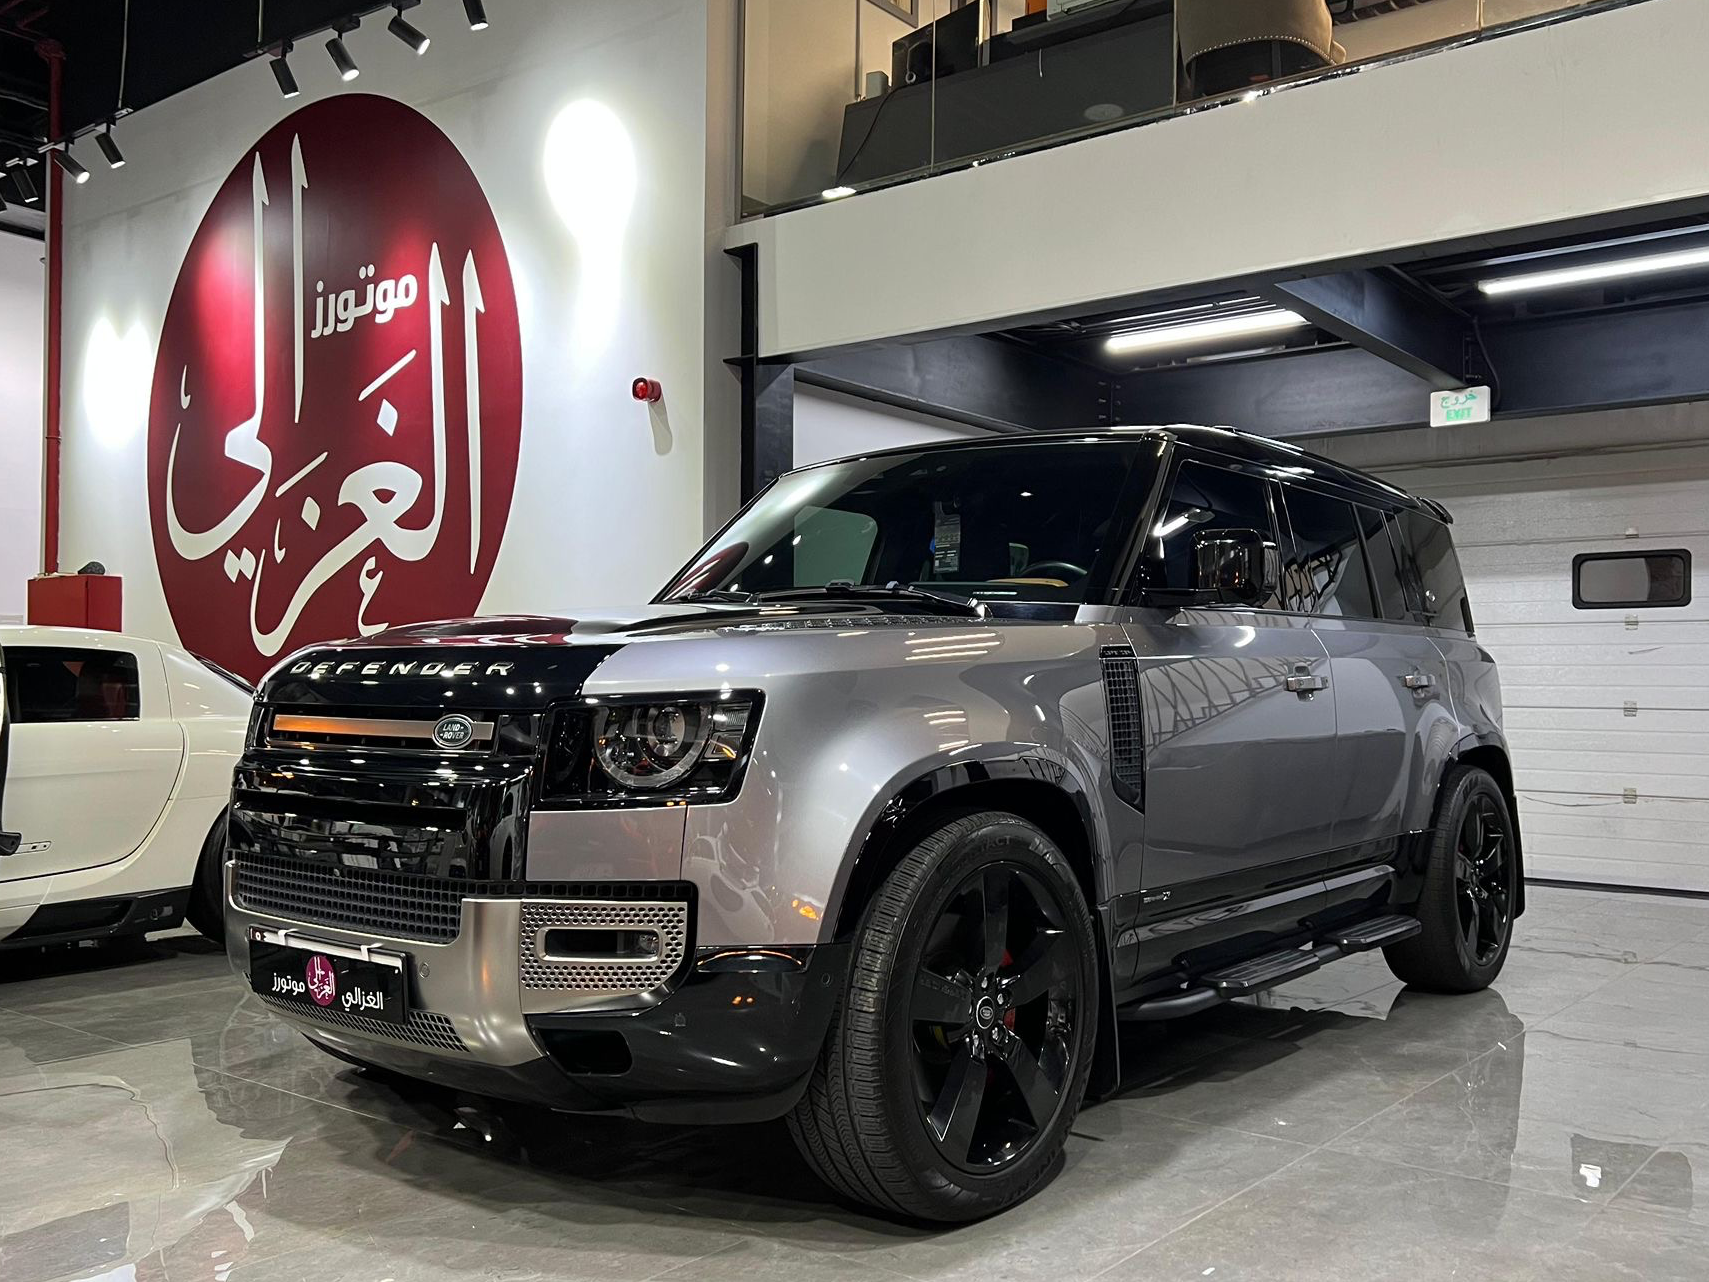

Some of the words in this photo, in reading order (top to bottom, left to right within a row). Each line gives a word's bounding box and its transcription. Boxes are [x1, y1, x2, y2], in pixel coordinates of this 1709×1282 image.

[310, 264, 419, 339] موتورز
[1441, 390, 1478, 408] خروج
[1446, 407, 1472, 421] EXIT
[289, 660, 515, 677] DEFENDER
[442, 723, 461, 731] LAND
[442, 731, 465, 740] ROVER
[272, 972, 306, 995] موتورز
[342, 987, 383, 1011] الغزالي
